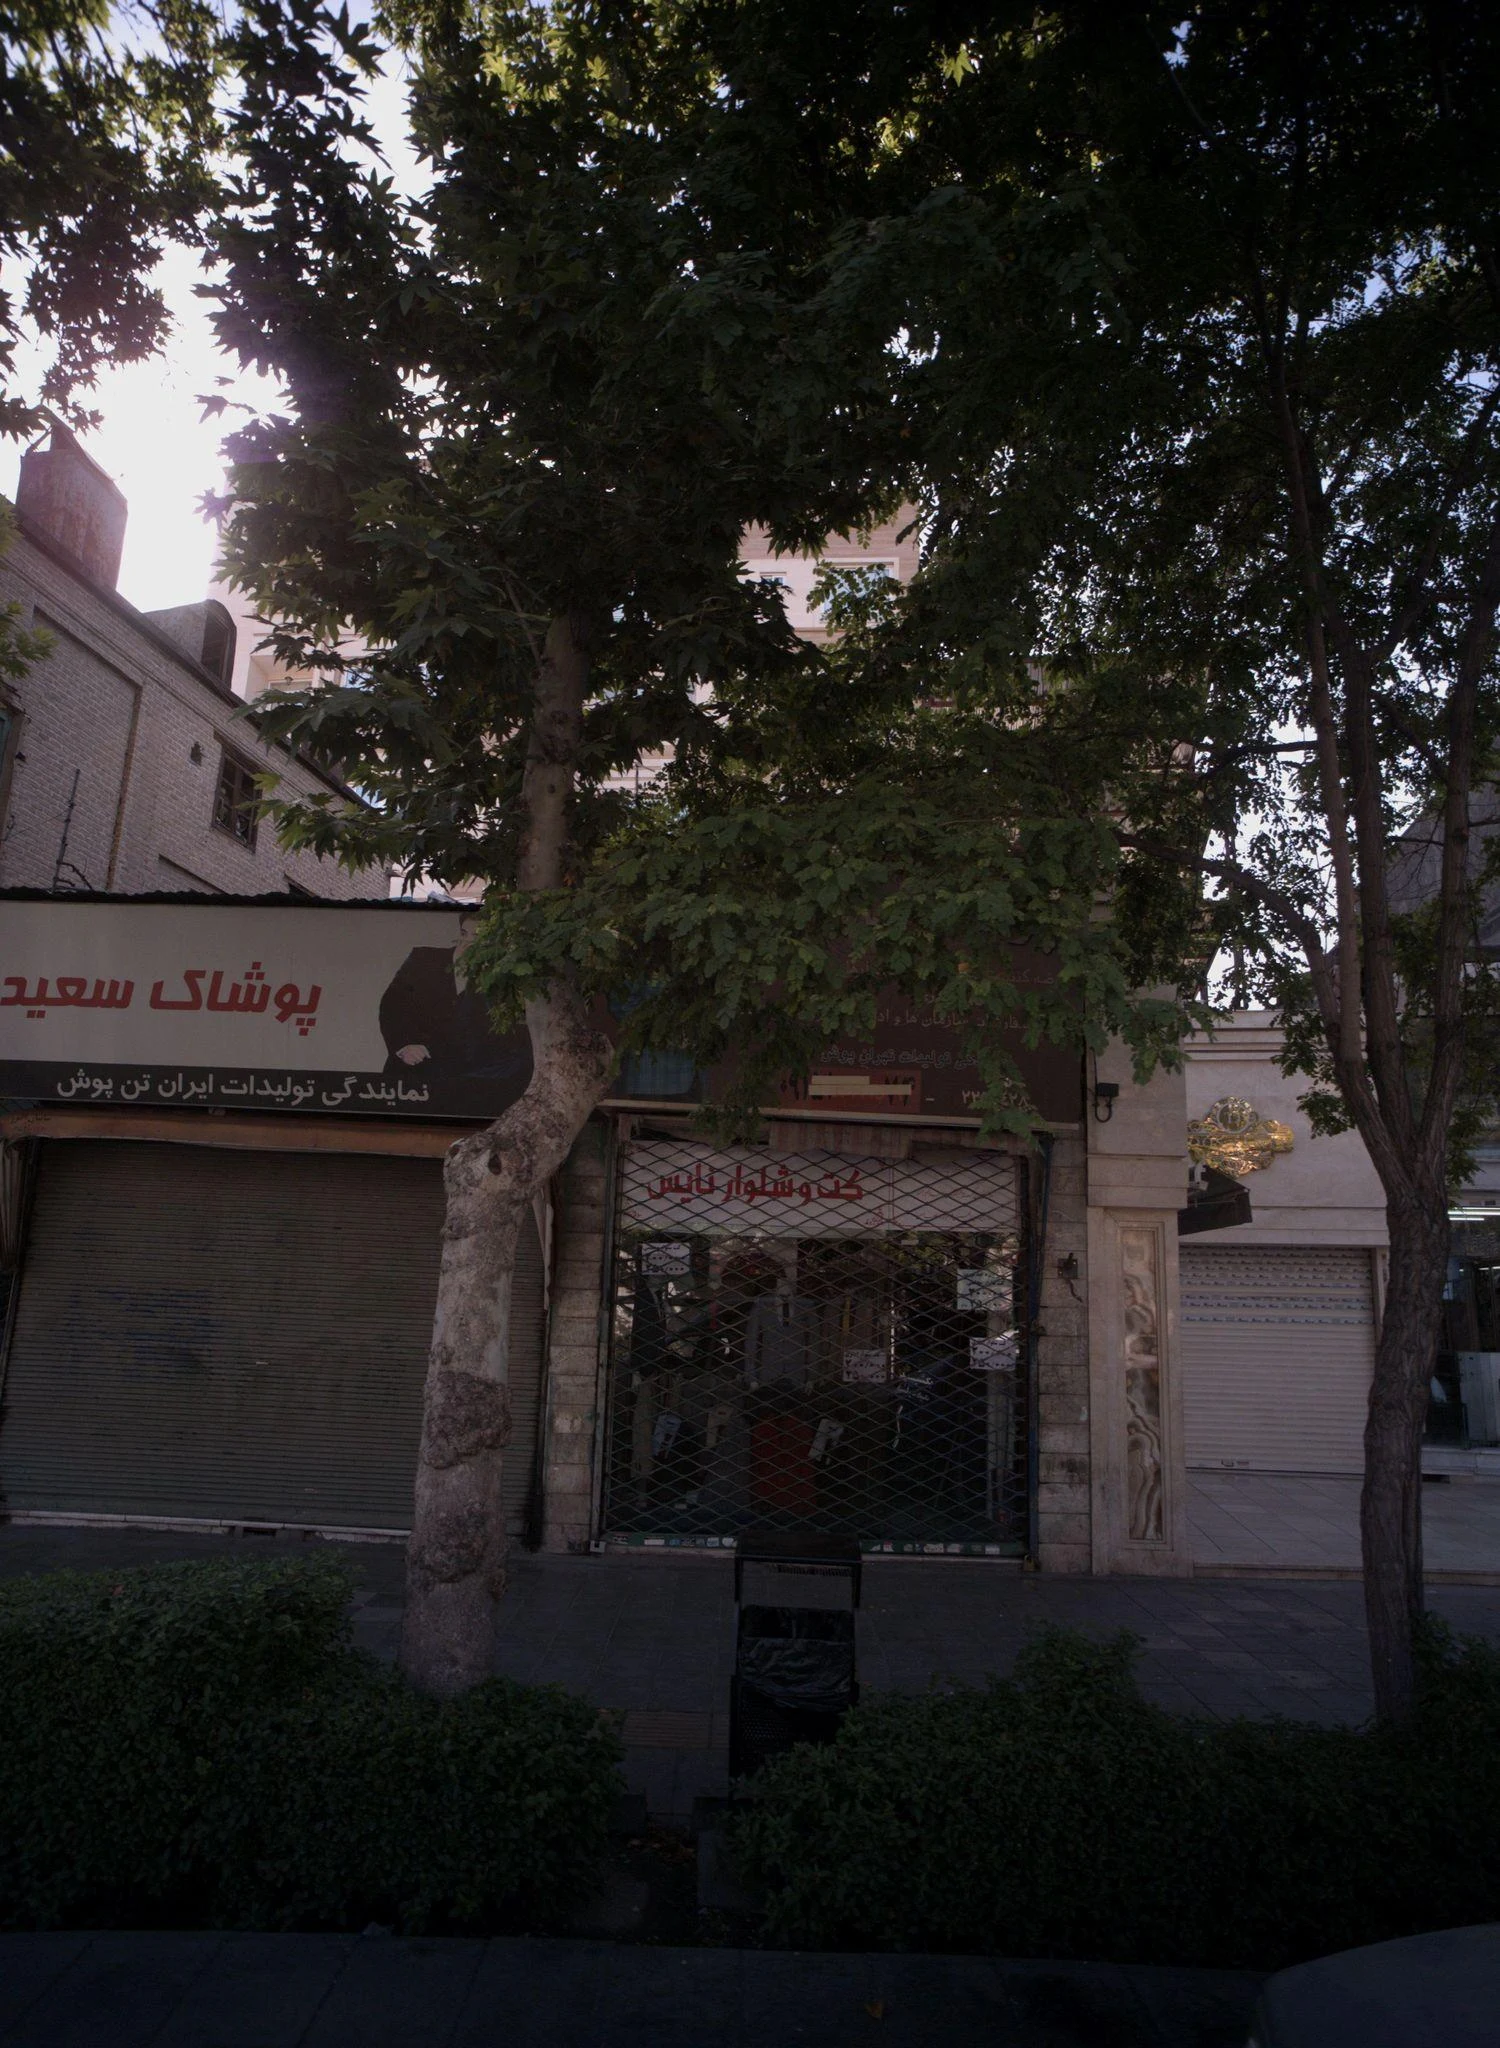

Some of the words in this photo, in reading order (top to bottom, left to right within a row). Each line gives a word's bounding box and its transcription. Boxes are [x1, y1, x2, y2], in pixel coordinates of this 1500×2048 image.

[0, 976, 134, 1018] سعید
[150, 961, 321, 1036] پوشاک
[57, 1069, 114, 1099] پوش
[120, 1073, 151, 1100] تن
[157, 1073, 214, 1101] ایران
[220, 1074, 315, 1105] تولیدات
[322, 1077, 430, 1105] نمایندگی
[721, 1164, 793, 1204] شلوار
[799, 1182, 812, 1206] و
[816, 1170, 864, 1201] کت
